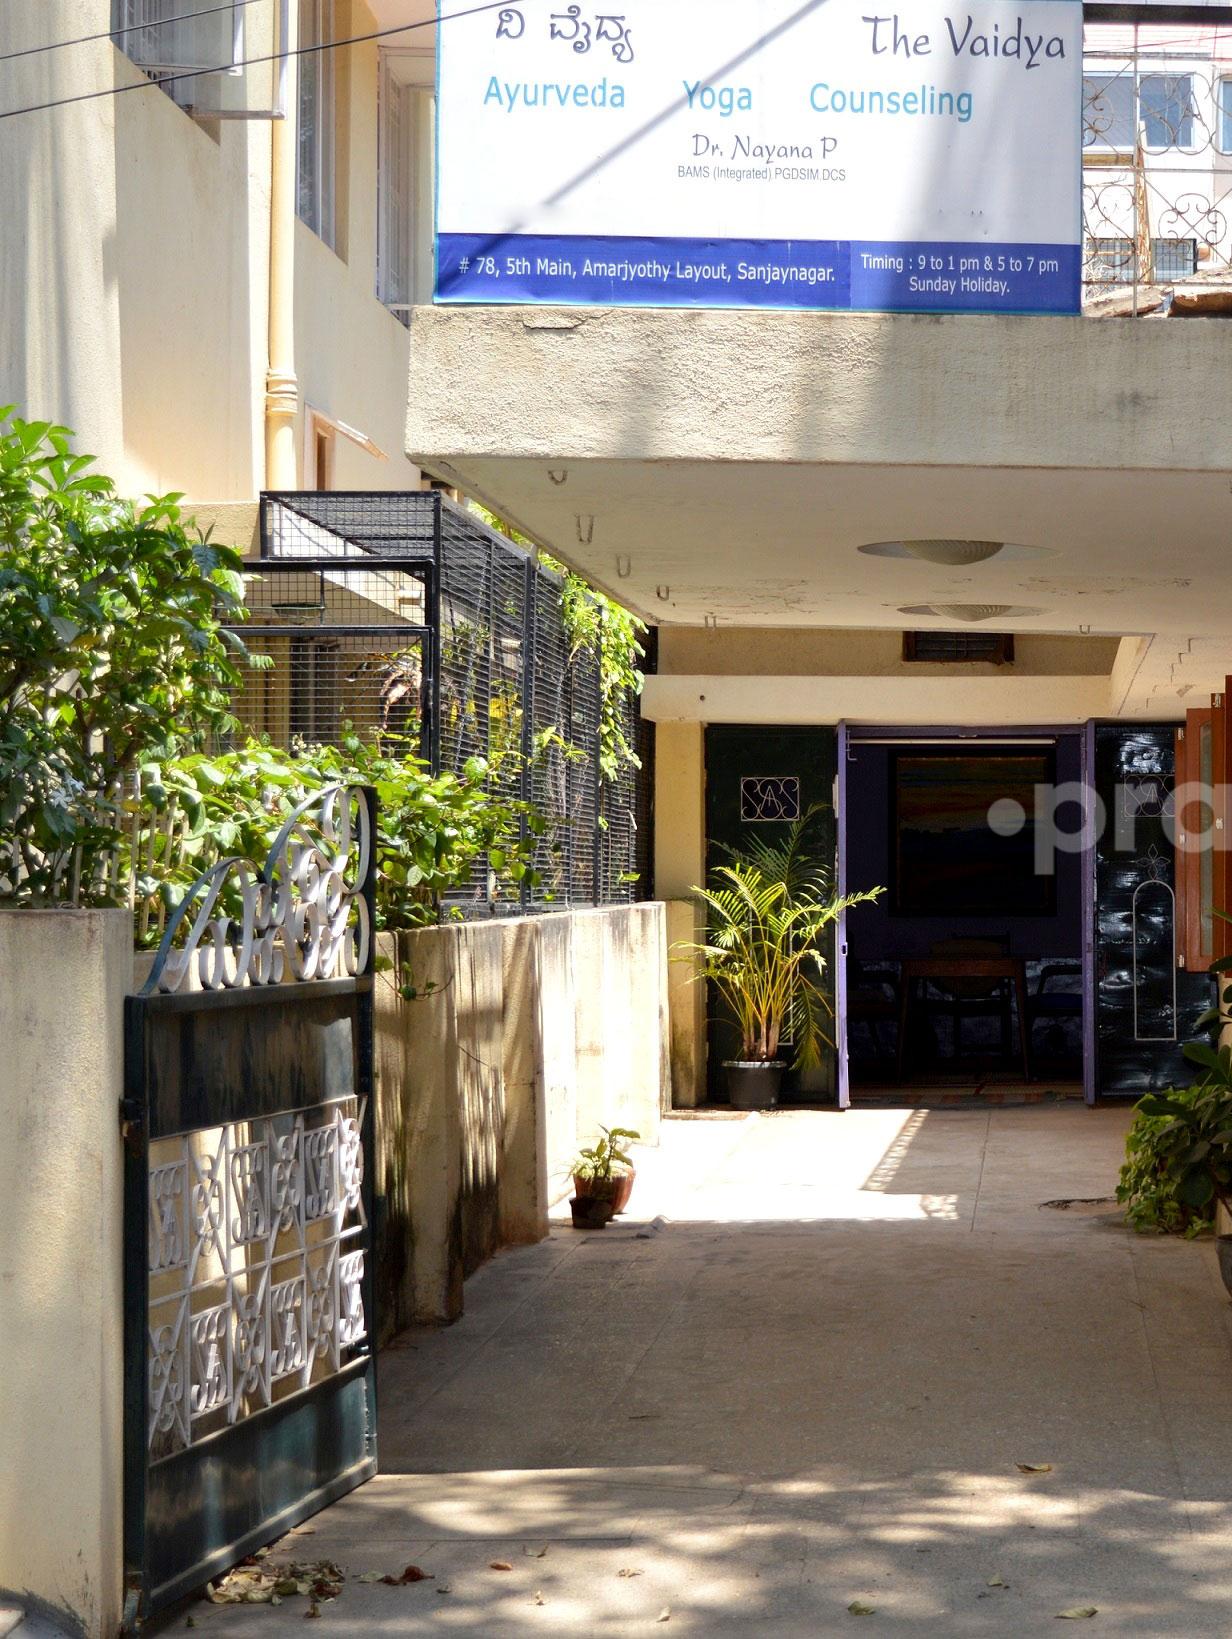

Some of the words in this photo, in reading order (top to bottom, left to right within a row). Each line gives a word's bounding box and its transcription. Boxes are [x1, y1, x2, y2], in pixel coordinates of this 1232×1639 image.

[862, 15, 932, 58] The
[944, 16, 1066, 70] Vaidya
[483, 76, 626, 113] Ayurveda
[682, 80, 752, 117] Yoga
[809, 83, 973, 122] Counseling
[692, 133, 723, 157] Dr.
[730, 134, 813, 164] Nayana
[820, 136, 838, 160] P
[678, 165, 710, 178] BAMS
[476, 257, 501, 278] 78,
[506, 257, 531, 276] 5th
[537, 257, 577, 279] Main,
[583, 259, 671, 282] Amarjyothy
[676, 261, 732, 283] Layout,
[737, 262, 836, 285] Sanjaynagar.
[861, 254, 904, 273] Timing
[918, 255, 926, 270] 9
[930, 256, 943, 271] to
[948, 256, 955, 271] 1
[960, 259, 980, 274] pm
[984, 256, 994, 271] &
[997, 256, 1006, 271] 5
[1009, 256, 1022, 272] to
[1026, 257, 1035, 272] 7
[1039, 260, 1059, 275] pm
[909, 276, 957, 295] Sunday
[961, 277, 1011, 297] Holiday.
